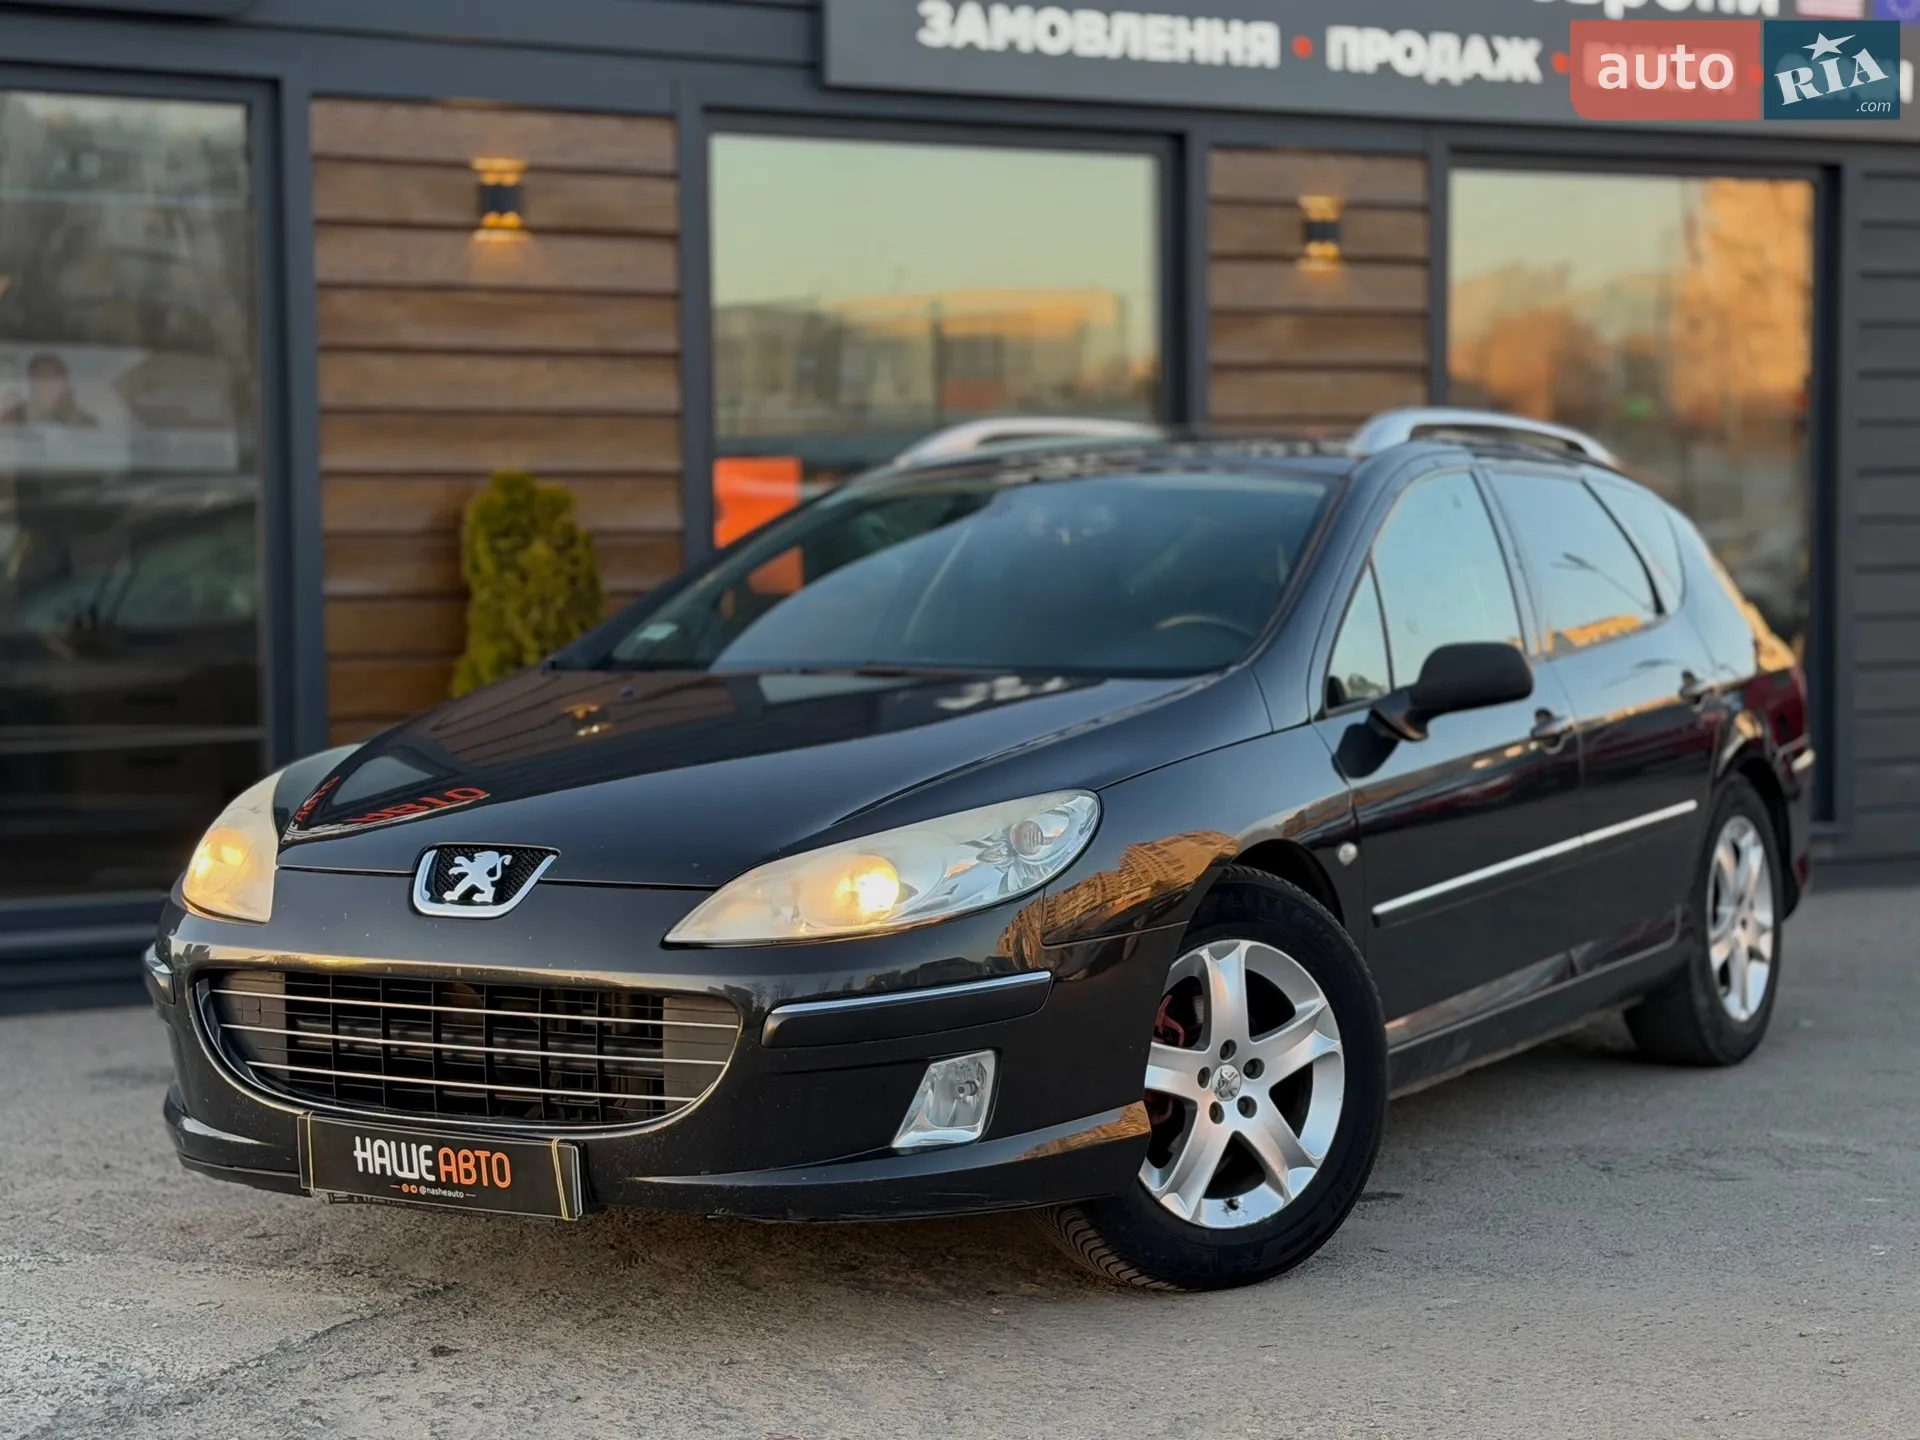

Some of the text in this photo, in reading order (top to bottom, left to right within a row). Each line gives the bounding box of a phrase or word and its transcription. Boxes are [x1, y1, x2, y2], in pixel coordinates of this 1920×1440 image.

[916, 0, 1282, 68] ЗАМОВЛЕННЯ
[1325, 24, 1544, 85] ПРОДАЖ
[419, 1185, 464, 1198] @nasheauto
